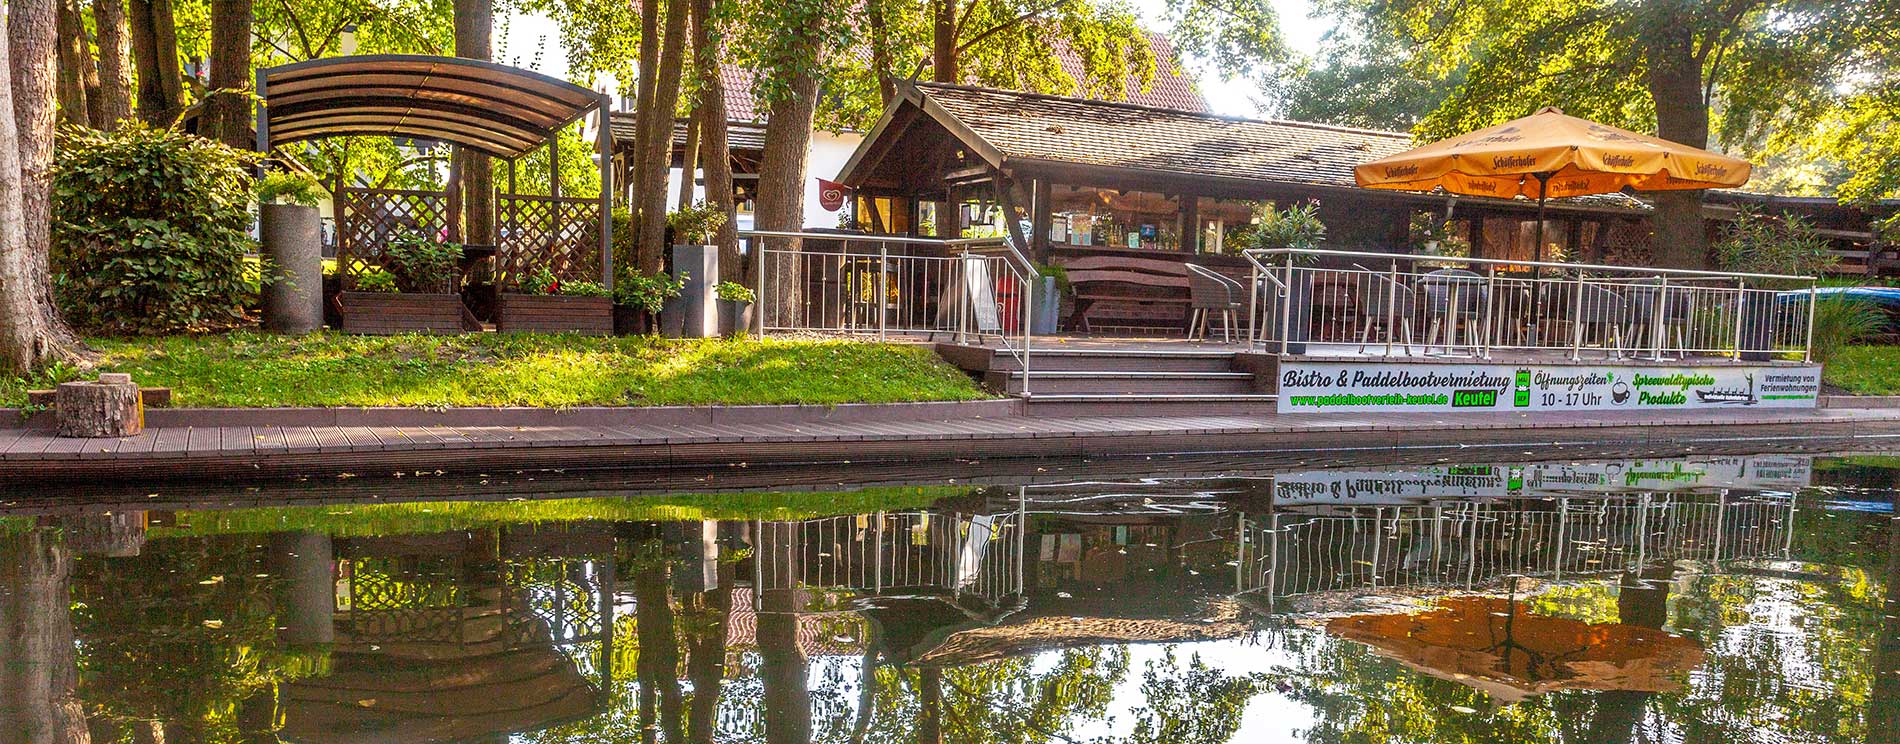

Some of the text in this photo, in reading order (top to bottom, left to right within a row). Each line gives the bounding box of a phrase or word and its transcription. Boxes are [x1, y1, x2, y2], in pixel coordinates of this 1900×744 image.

[1283, 369, 1511, 395] Bistro & Paddelbootvermietung
[1534, 370, 1607, 390] Öffnungszeiten
[1632, 373, 1716, 392] Spreewaldtypische
[1765, 374, 1801, 384] Vermietung
[1760, 383, 1817, 393] Ferienwohnungen
[1290, 393, 1449, 408] www.paddelbootverleih-keutel.de
[1455, 391, 1495, 406] Keutel
[1542, 393, 1555, 406] 10
[1566, 393, 1579, 406] 17
[1582, 392, 1602, 406] Uhr
[1638, 391, 1687, 405] Produkte
